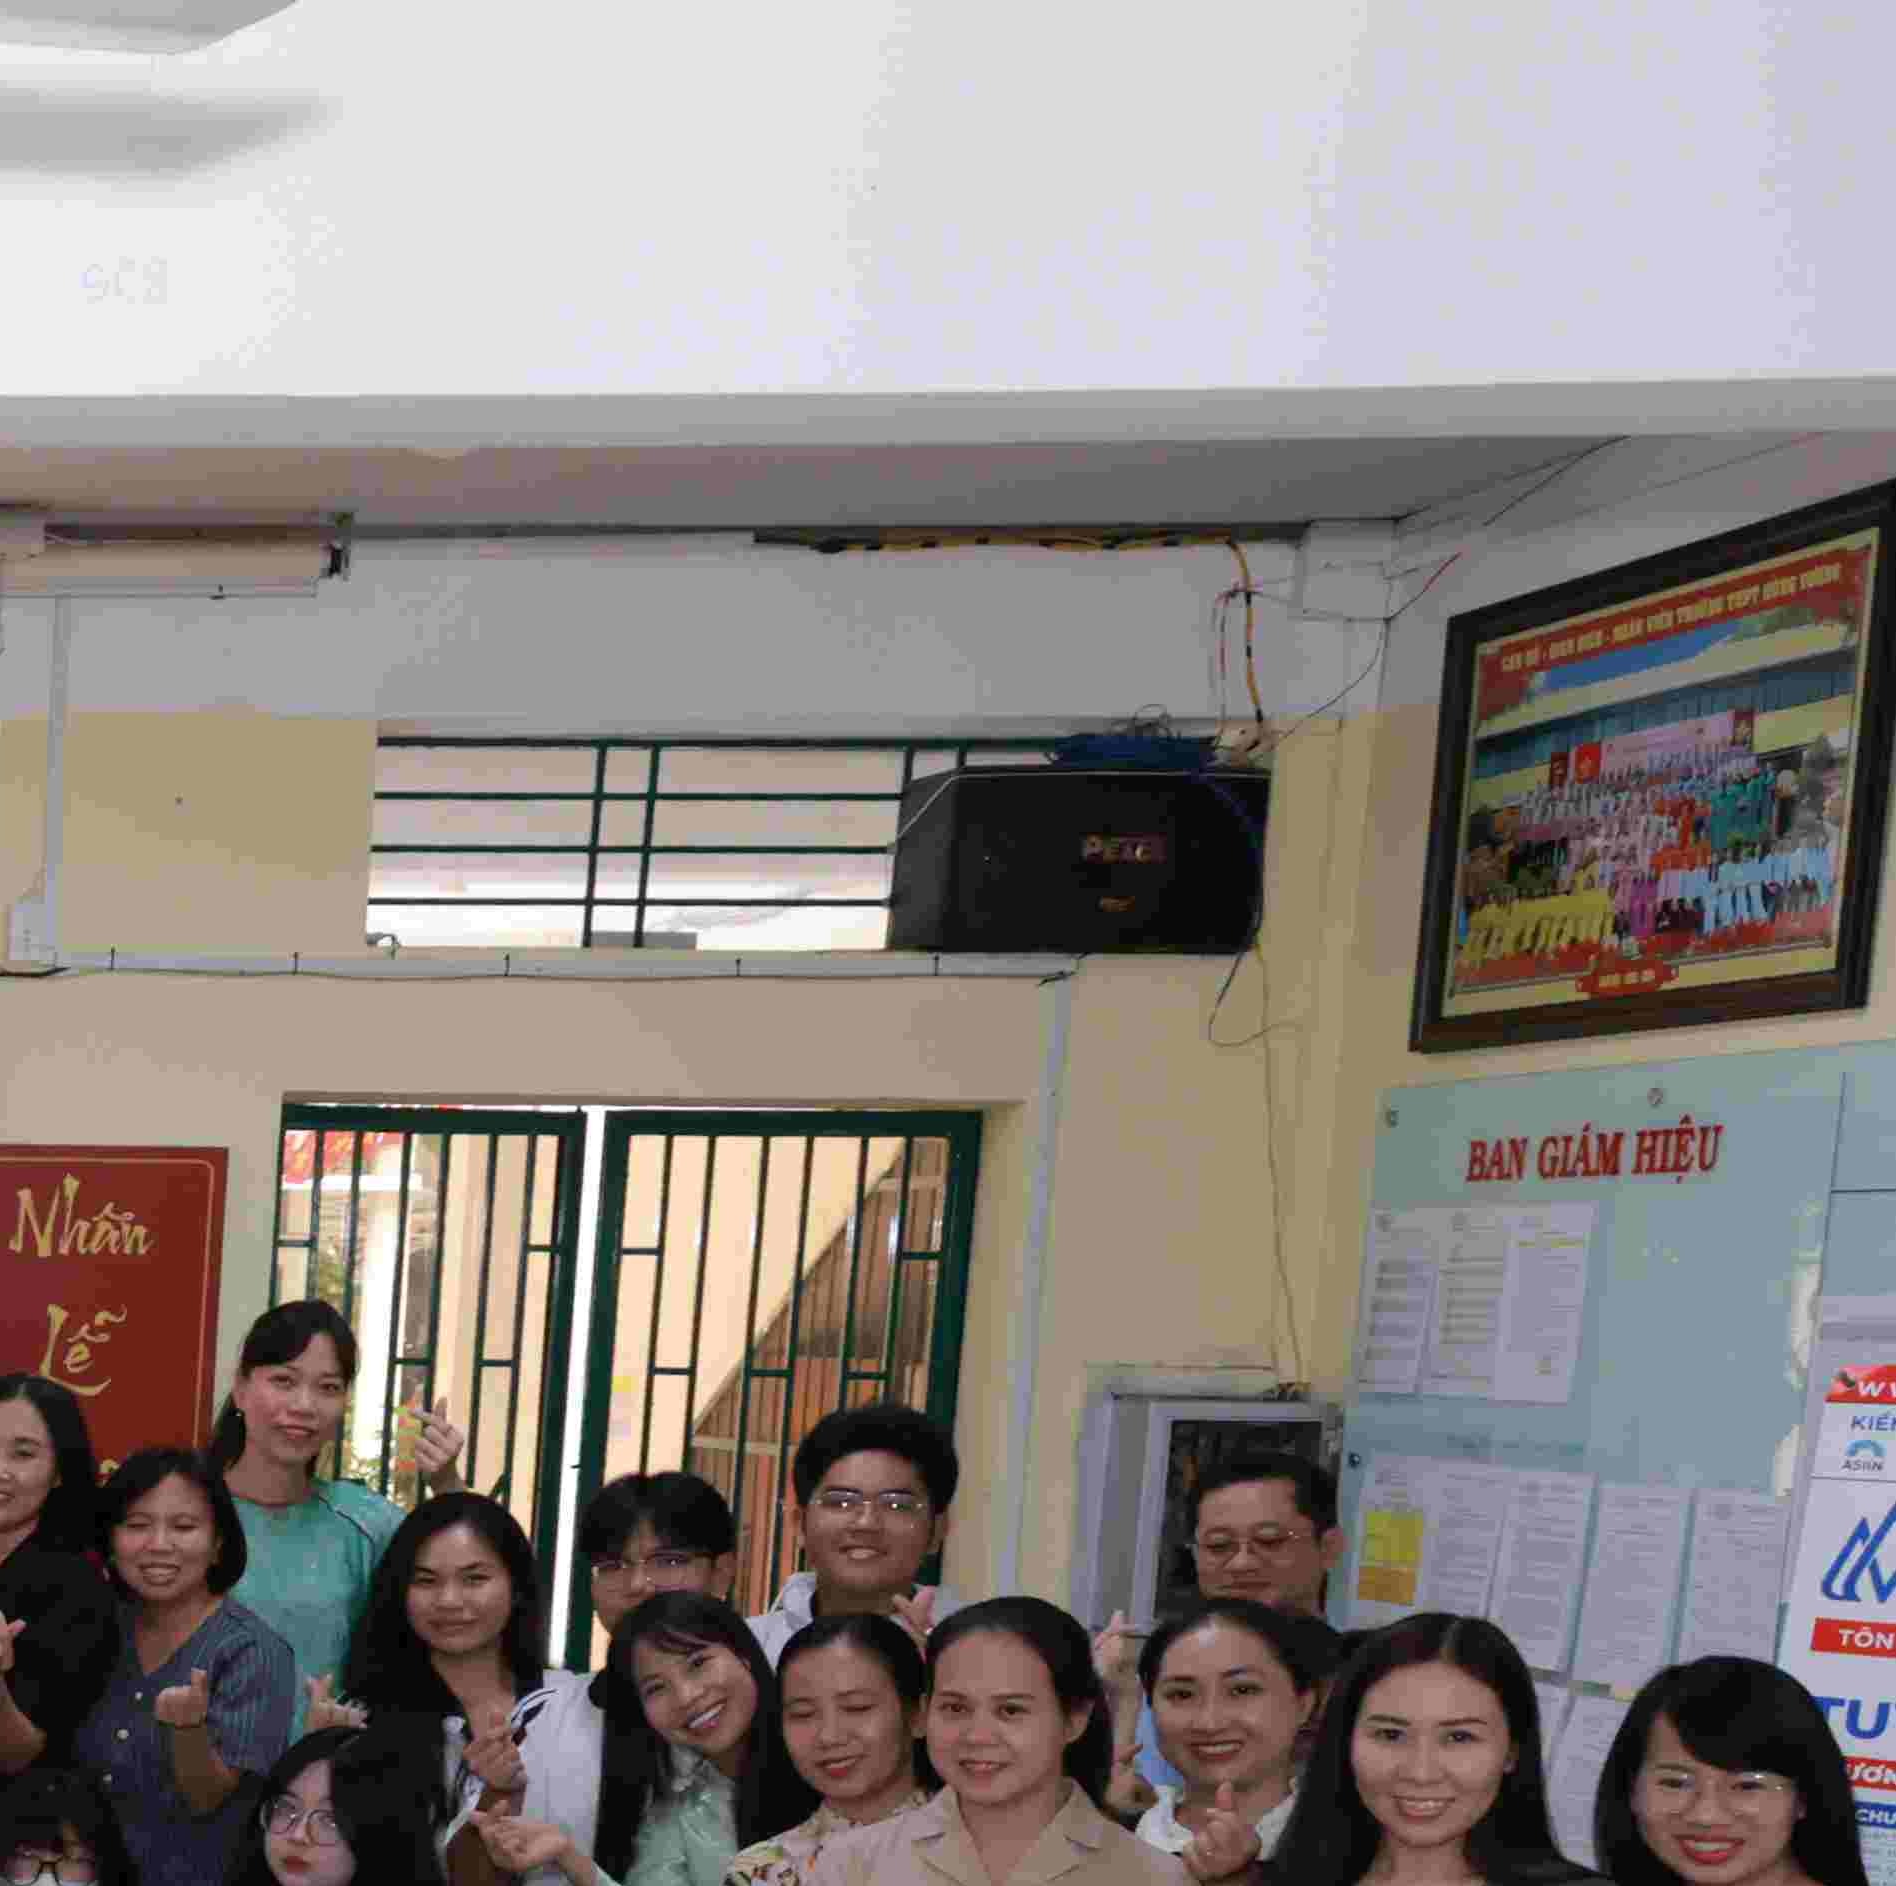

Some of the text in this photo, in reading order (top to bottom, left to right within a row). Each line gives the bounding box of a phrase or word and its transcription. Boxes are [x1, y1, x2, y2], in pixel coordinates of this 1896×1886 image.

[1466, 1113, 1724, 1185] BAN GIÁM HIỆU
[9, 1173, 154, 1258] Nhân
[1838, 1625, 1894, 1650] TÔN
